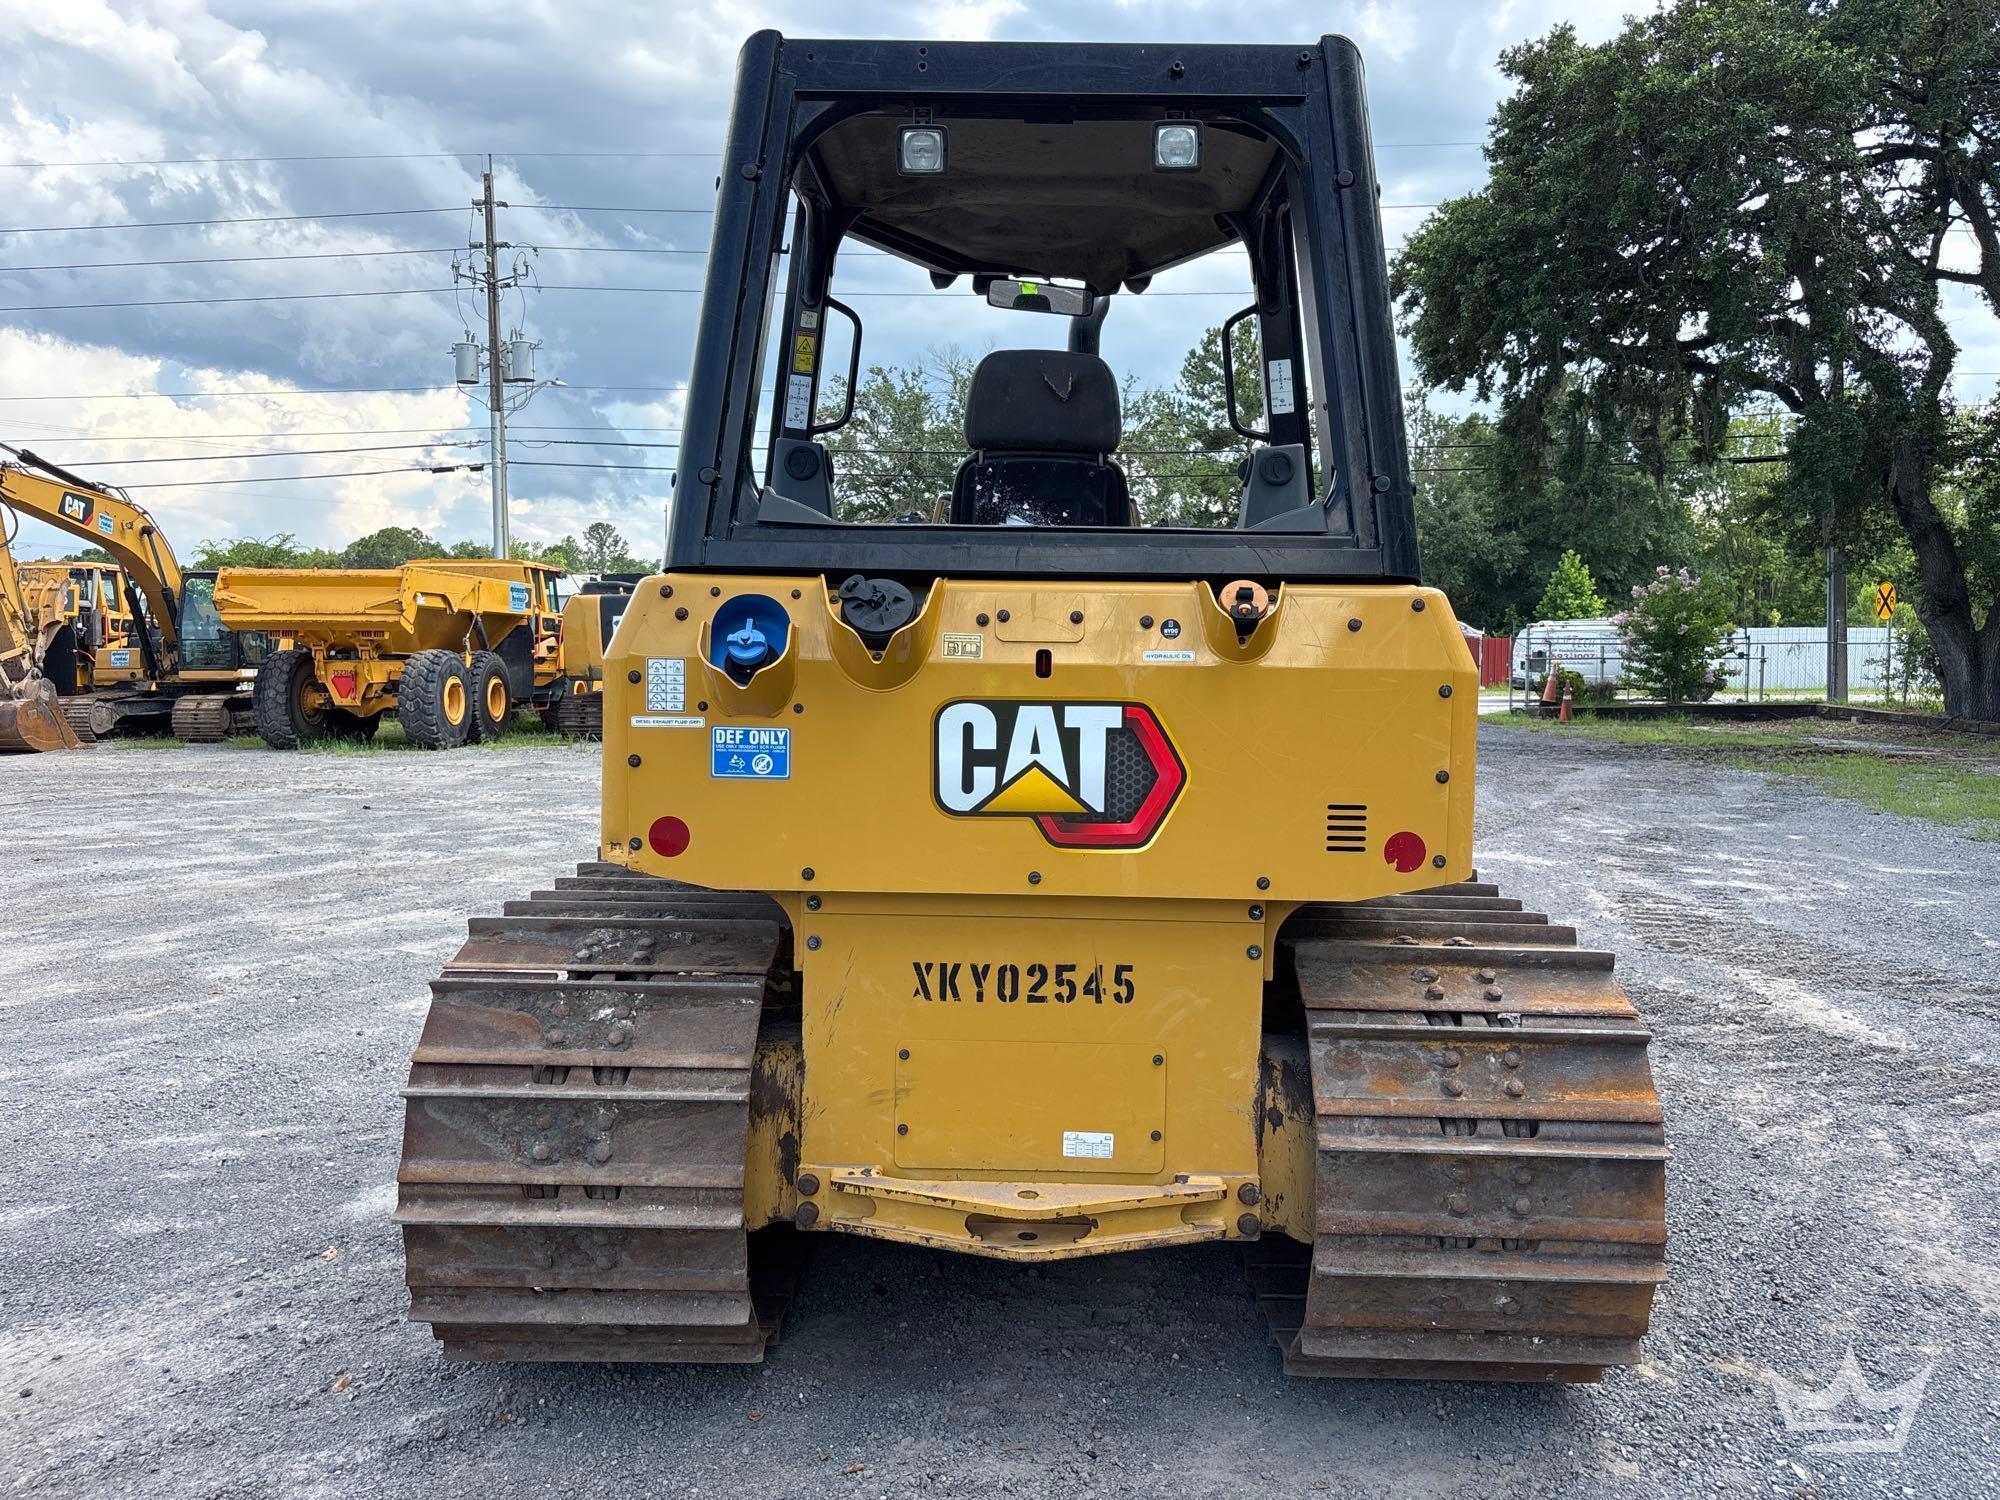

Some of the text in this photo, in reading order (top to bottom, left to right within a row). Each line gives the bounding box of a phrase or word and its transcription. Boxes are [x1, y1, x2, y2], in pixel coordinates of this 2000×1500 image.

[65, 495, 86, 520] CAT
[715, 729, 787, 745] DEF ONLY
[938, 702, 1122, 813] CAT
[912, 961, 1135, 1004] XKY02545
